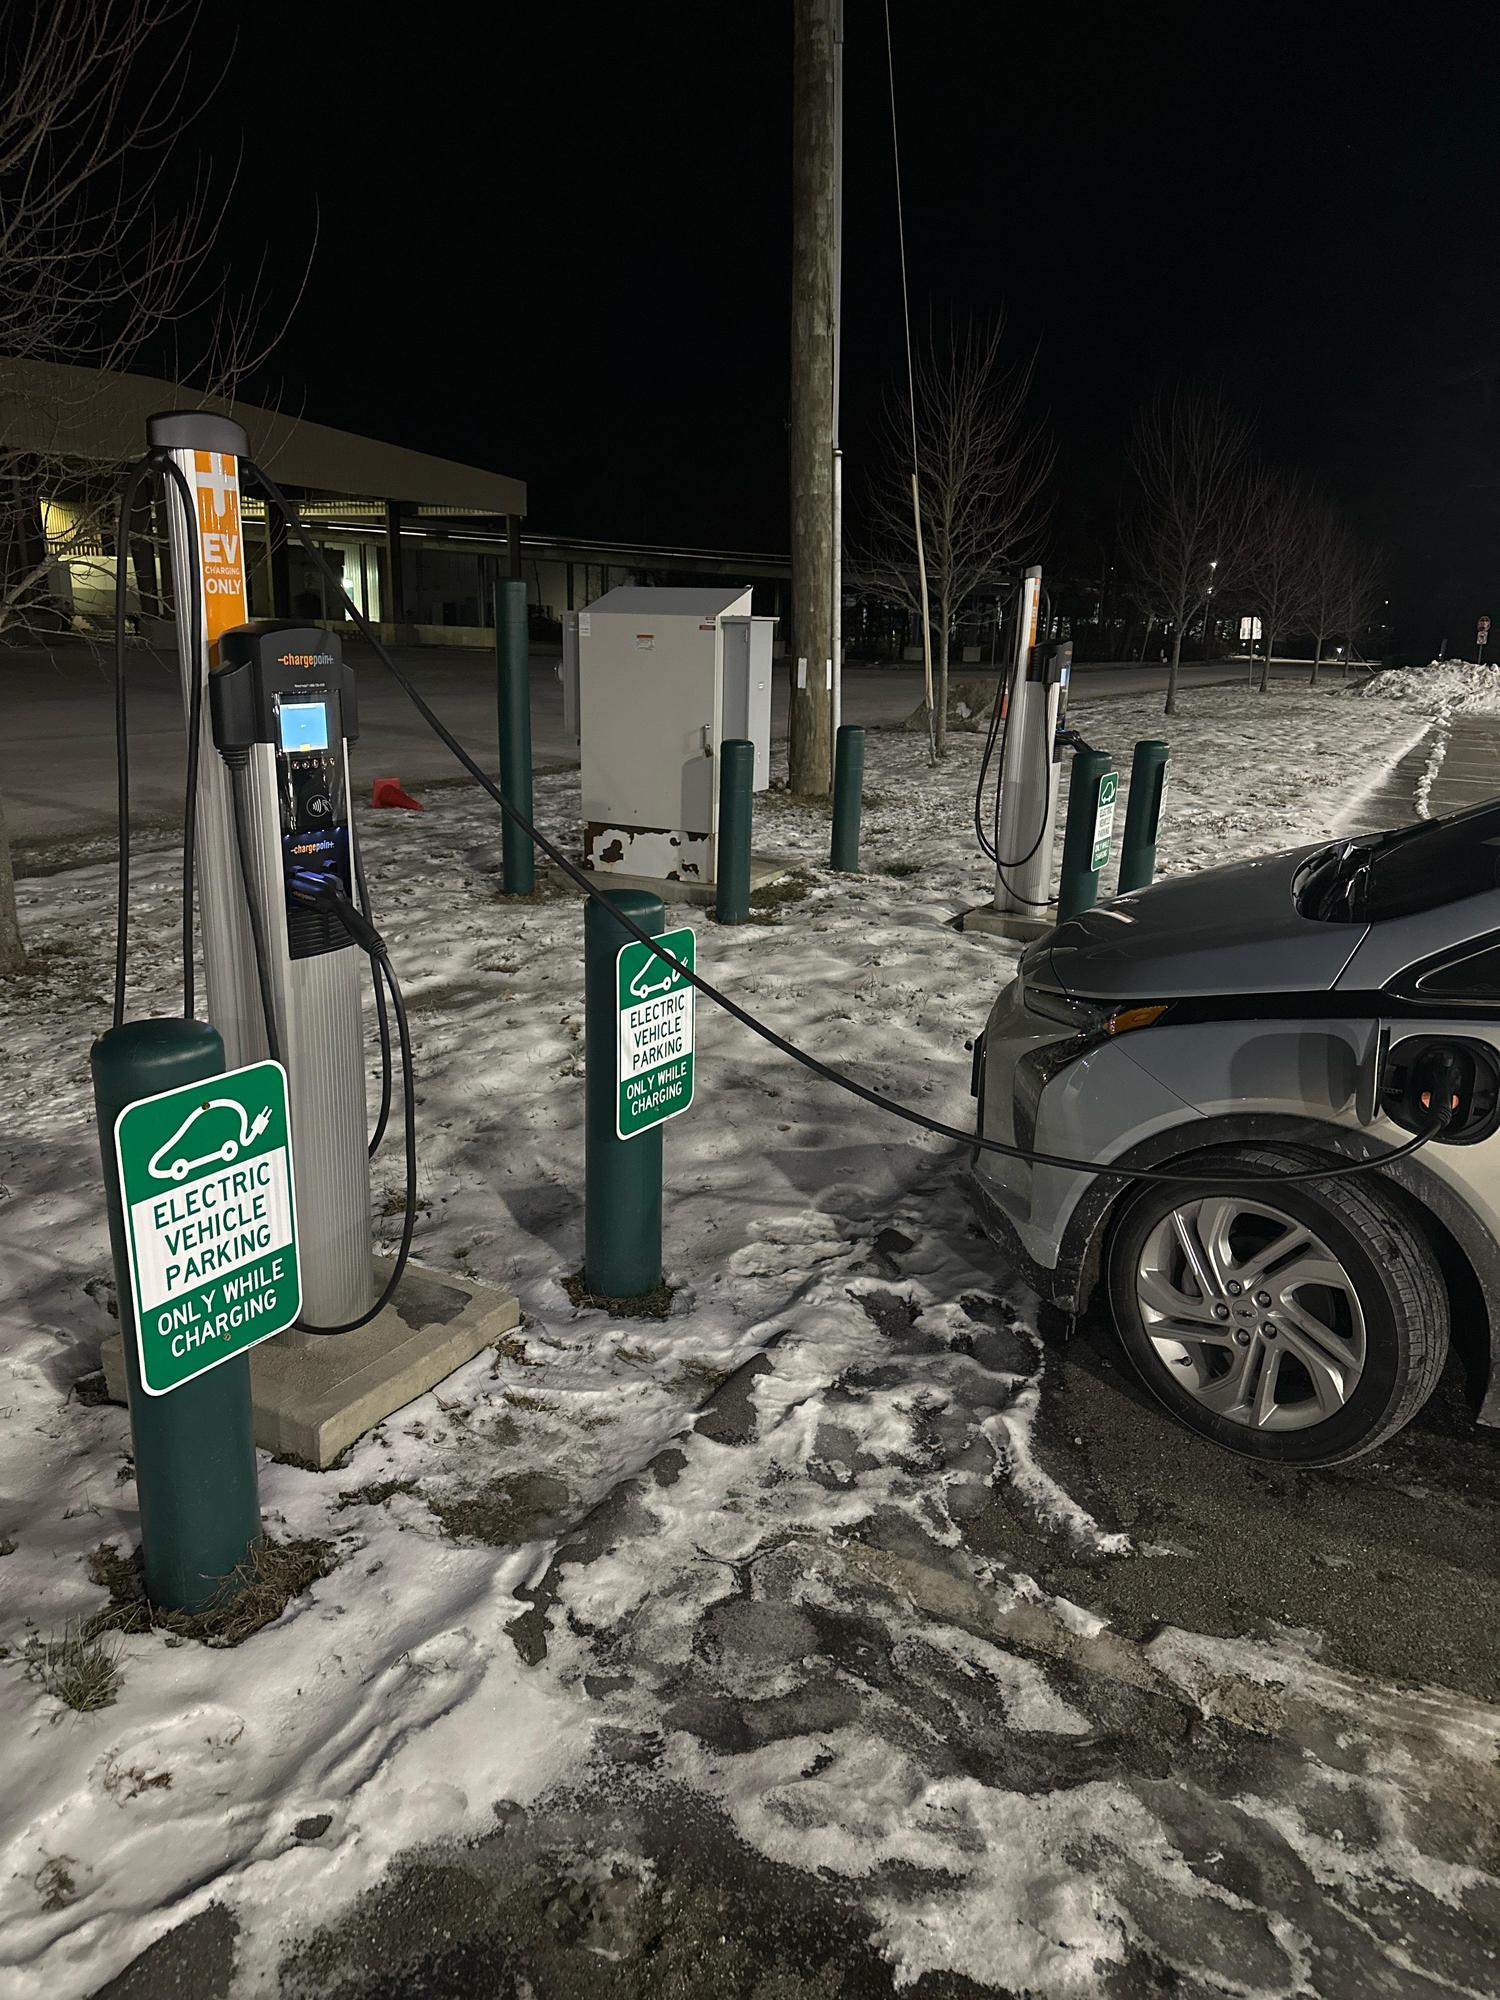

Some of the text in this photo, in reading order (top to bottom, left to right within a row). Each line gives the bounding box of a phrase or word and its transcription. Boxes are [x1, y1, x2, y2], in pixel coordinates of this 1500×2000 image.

[202, 533, 238, 564] EV
[205, 566, 240, 575] CHARGING
[206, 578, 241, 595] ONLY
[630, 994, 685, 1029] ELECTRIC
[634, 1016, 682, 1048] VEHICLE
[632, 1036, 683, 1071] PARKING
[626, 1062, 687, 1100] ONLY WHILE
[631, 1081, 682, 1116] CHARGING
[153, 1161, 271, 1230] ELECTRIC
[164, 1194, 268, 1257] VEHICLE
[165, 1223, 272, 1292] PARKING
[157, 1257, 285, 1336] ONLY WHILE
[170, 1288, 278, 1358] CHARGING
